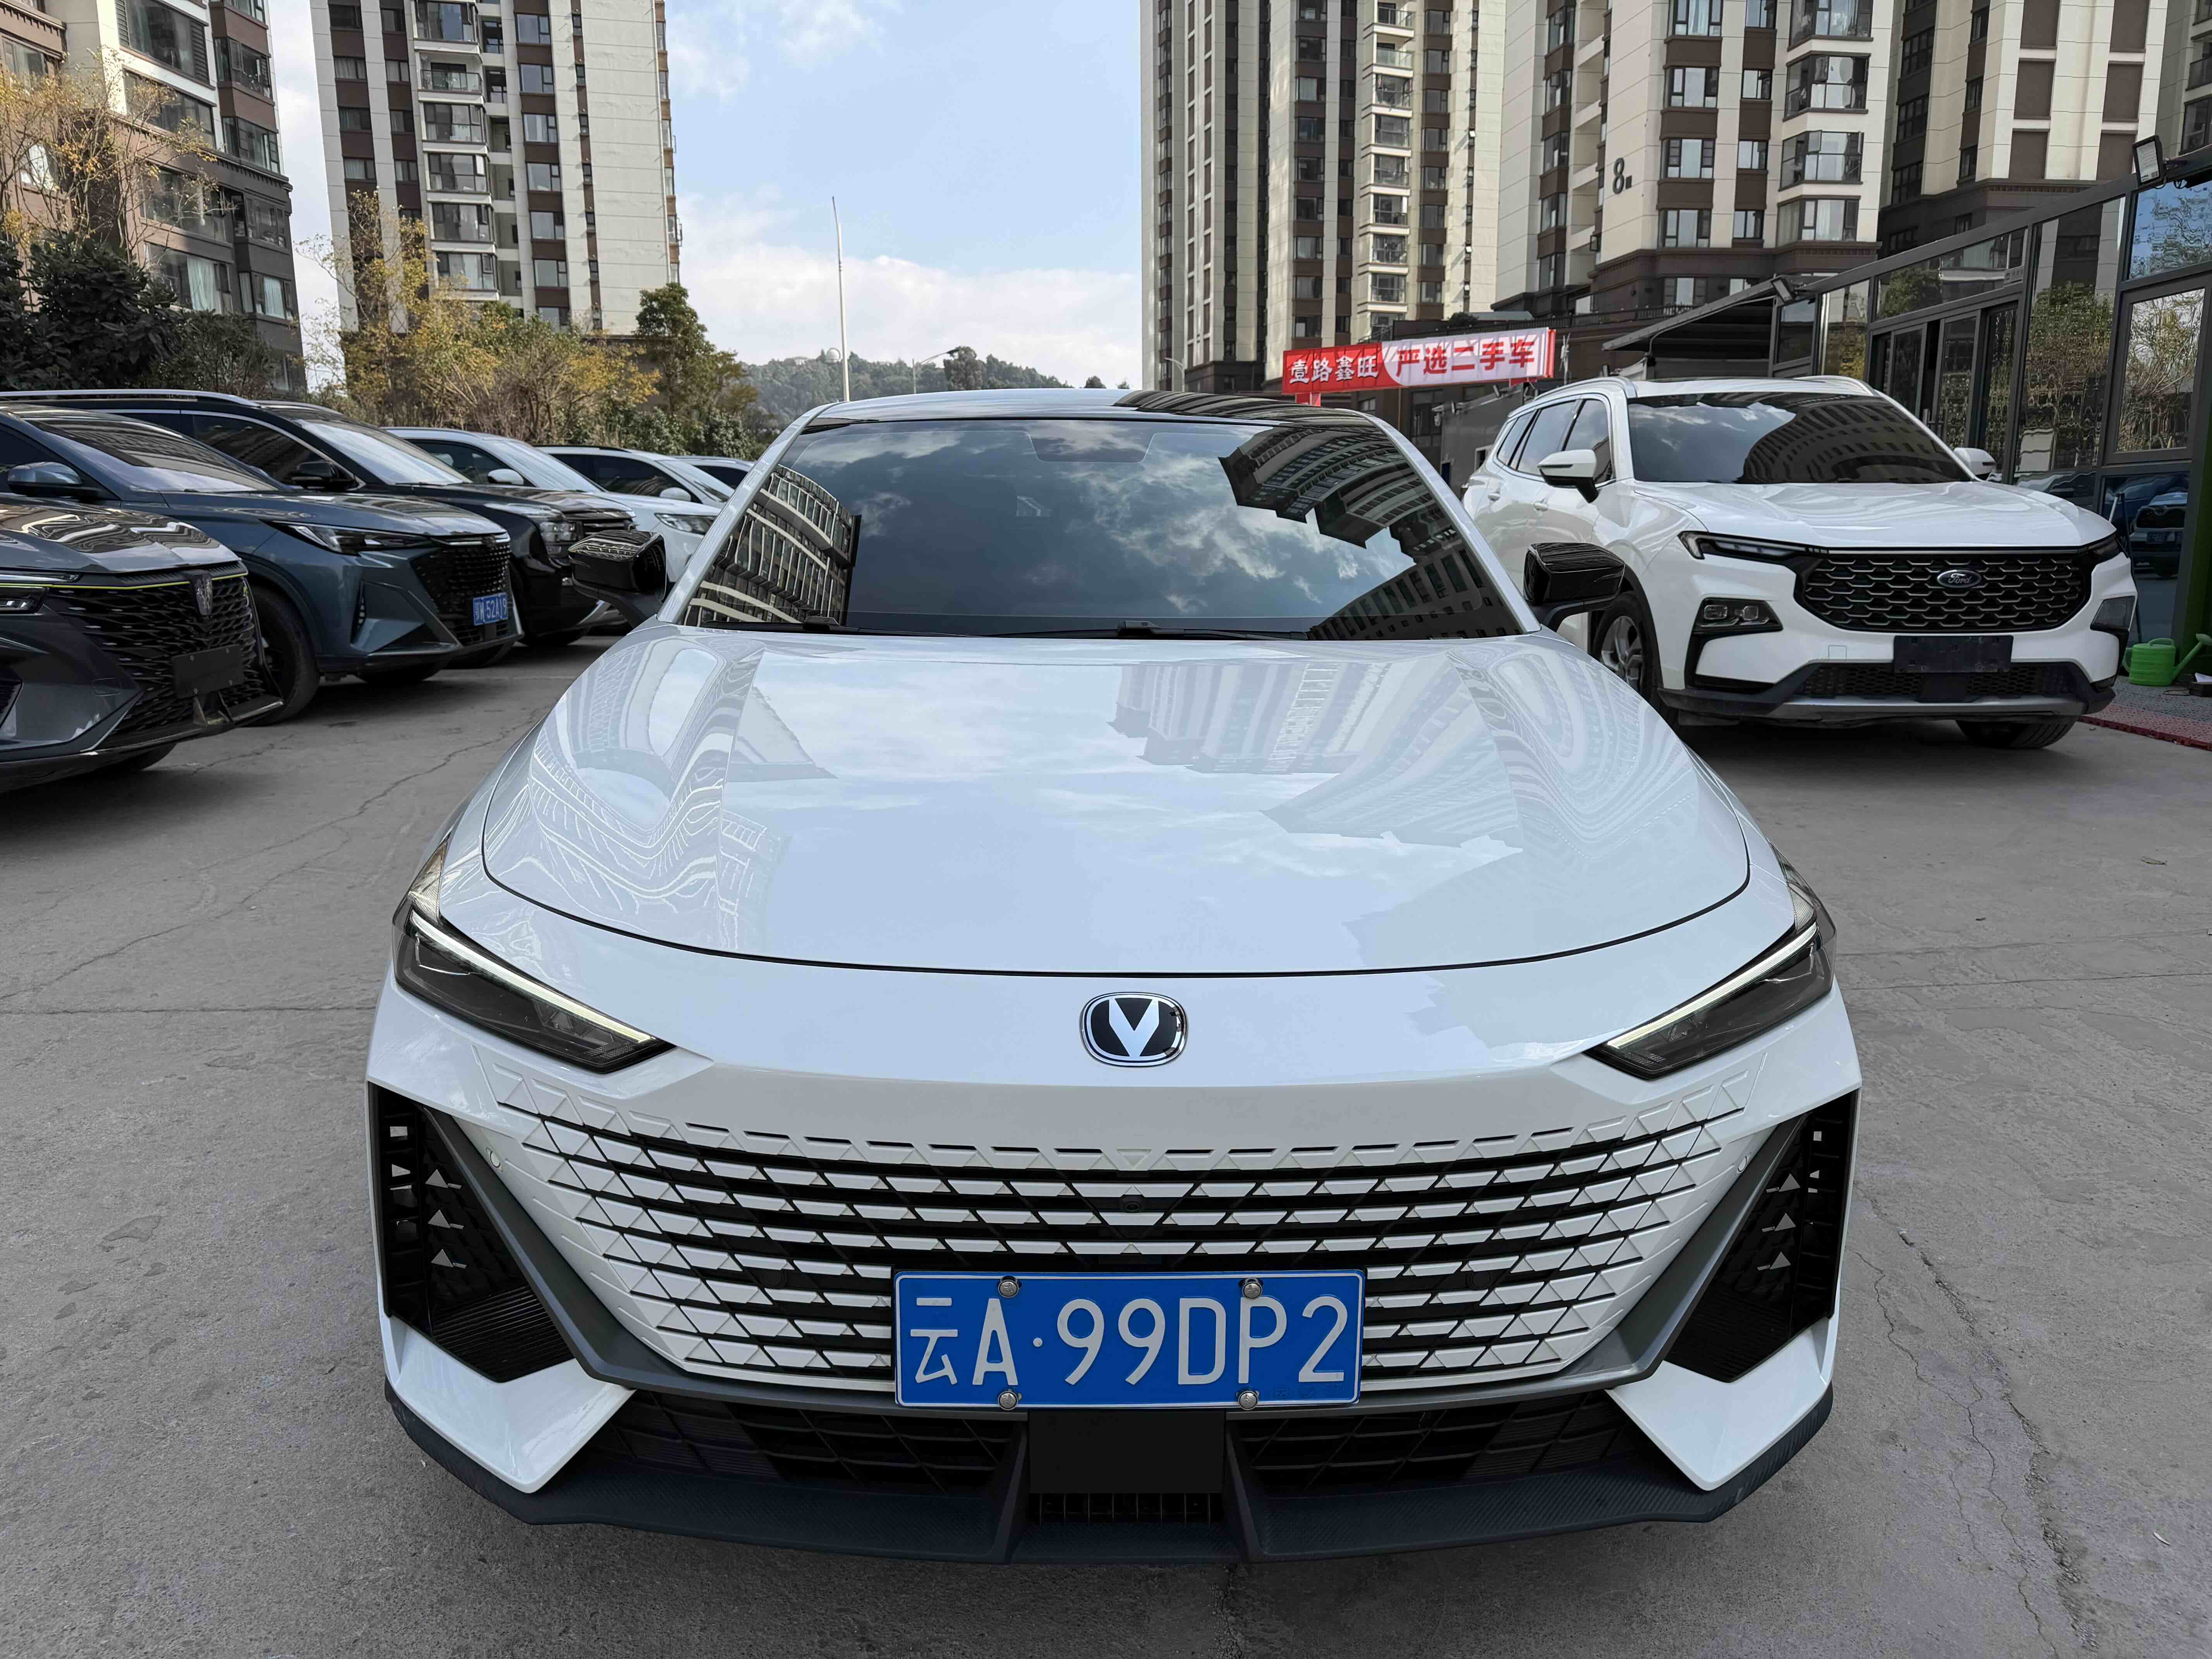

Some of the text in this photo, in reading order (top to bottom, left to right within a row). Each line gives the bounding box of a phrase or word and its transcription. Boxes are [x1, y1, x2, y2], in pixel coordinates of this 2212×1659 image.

[1289, 339, 1535, 385] 壹路鑫旺 严选二手车
[1948, 573, 1972, 584] Ford
[910, 1295, 1350, 1385] 云A·99DP2
